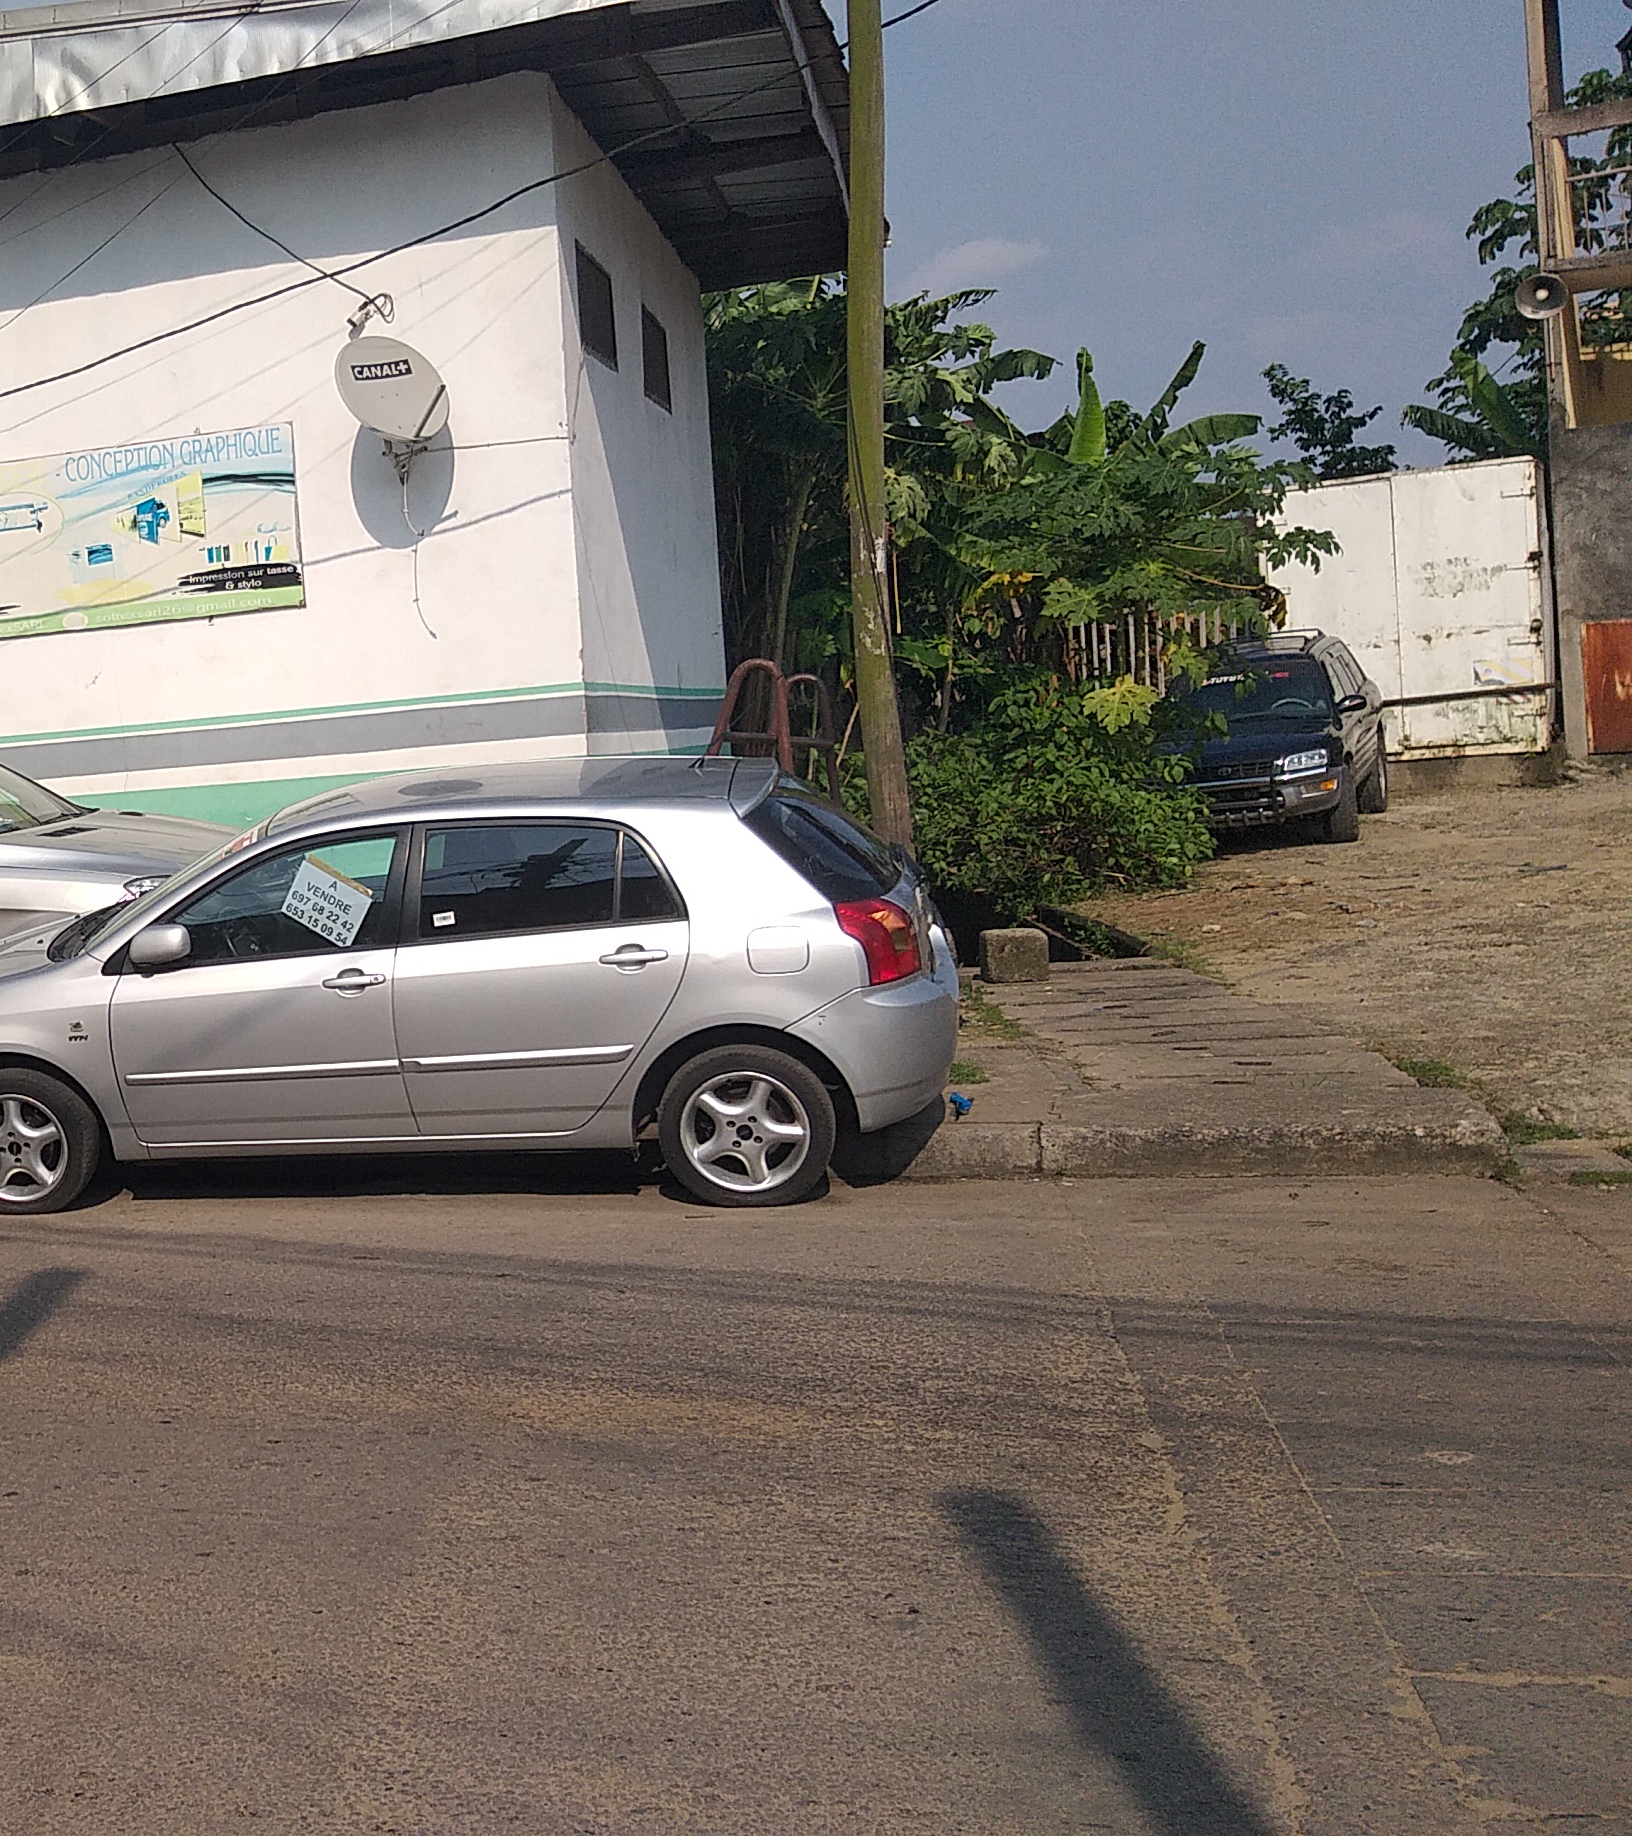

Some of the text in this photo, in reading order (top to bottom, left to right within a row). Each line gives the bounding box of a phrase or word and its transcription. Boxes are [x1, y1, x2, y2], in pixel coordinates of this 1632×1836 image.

[354, 362, 408, 378] CANAL+
[65, 442, 176, 482] CONCEPTION
[180, 428, 282, 465] GRAPHIQUE
[188, 564, 294, 586] Impression sur tasse
[237, 579, 263, 590] stylo
[306, 881, 353, 915] VENDRE
[329, 881, 338, 892] A
[286, 903, 349, 945] 653 15 09 54
[291, 890, 355, 934] 697 68 22 42
